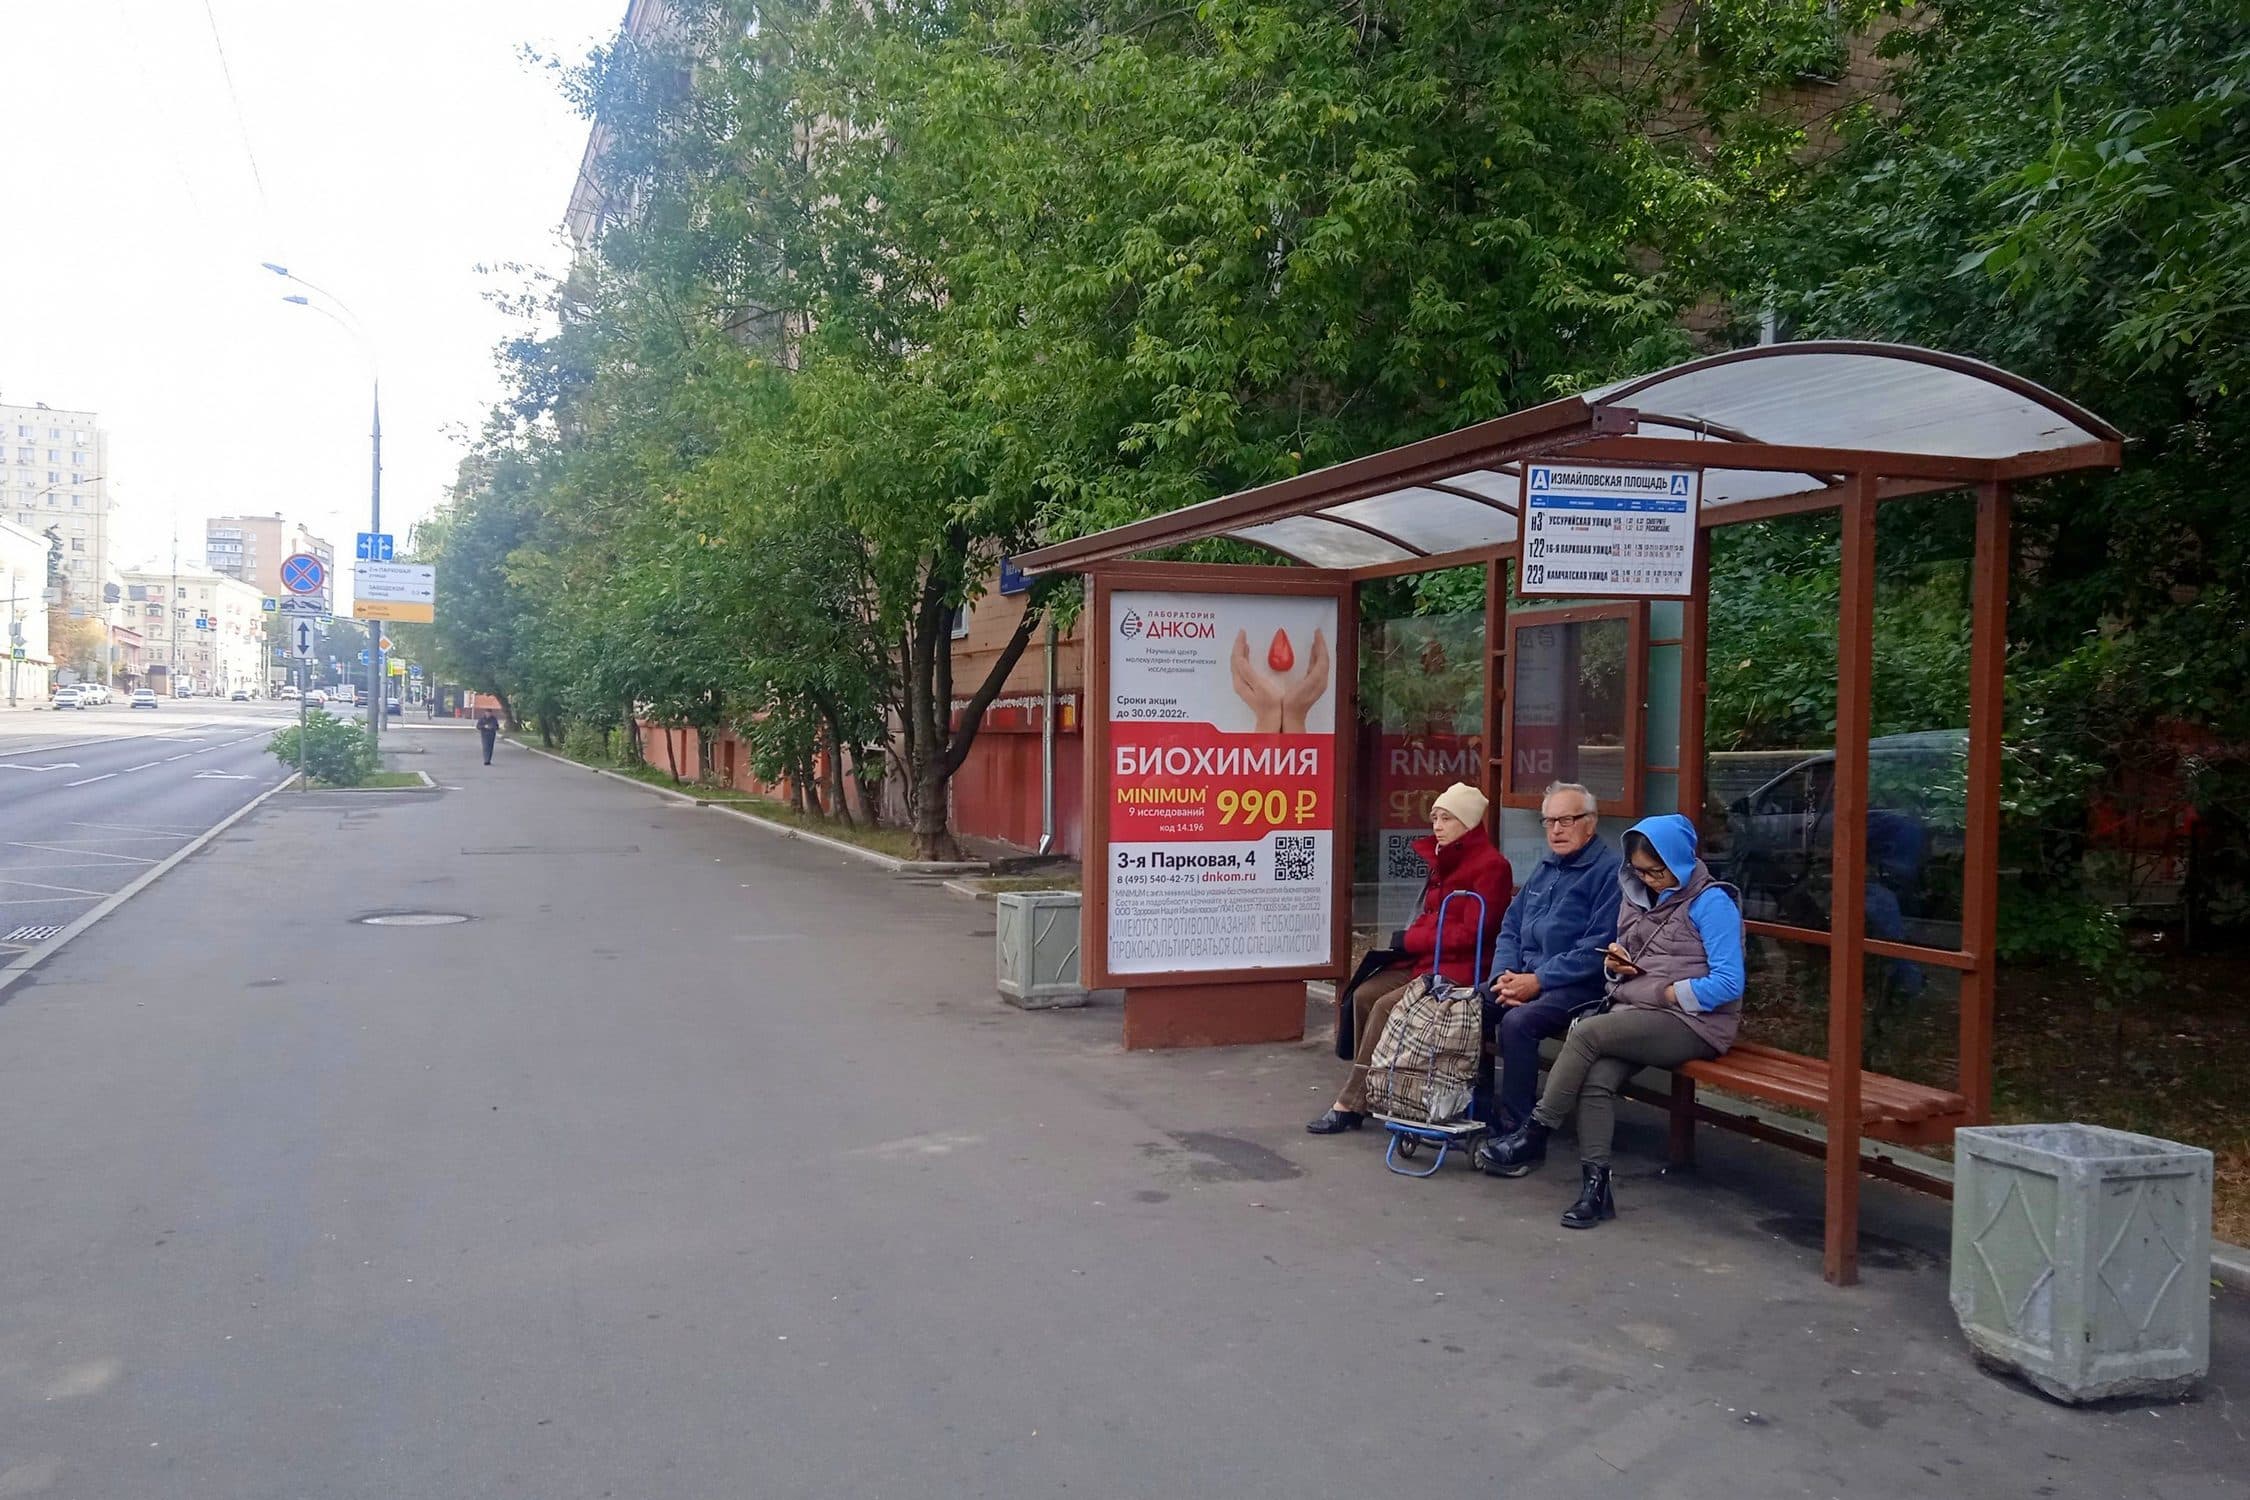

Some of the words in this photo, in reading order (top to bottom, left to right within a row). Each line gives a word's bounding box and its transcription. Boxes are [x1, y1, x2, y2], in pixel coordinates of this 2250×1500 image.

[1551, 471, 1622, 487] ИЗМАЙЛОВСКАЯ
[1624, 475, 1668, 490] ПЛОЩАДЬ
[1549, 515, 1591, 527] УССУРИЙСКАЯ
[1592, 517, 1612, 528] УЛИЦА
[1560, 544, 1592, 555] ПАРКОВАЯ
[1593, 546, 1612, 556] УЛИЦА
[1527, 564, 1544, 585] 223
[1547, 570, 1588, 580] КАМЧАТСКАЯ
[1589, 571, 1608, 582] УЛИЦА
[1148, 611, 1215, 619] ЛАБОРАТОРИЯ
[1146, 621, 1215, 639] ДНКОМ
[1117, 696, 1147, 705] Сроки
[1149, 697, 1177, 706] акции
[1116, 710, 1130, 719] до
[1131, 708, 1190, 719] 30.09.2022г.
[1116, 746, 1319, 776] БИОХИМИЯ
[1128, 807, 1136, 817] 9
[1137, 806, 1205, 819] исследований
[1159, 823, 1176, 833] код
[1177, 822, 1204, 832] 14.196
[1118, 852, 1147, 869] 3-я
[1151, 851, 1242, 871] Парковая,
[1244, 850, 1256, 867] 4
[1117, 874, 1123, 885] 8
[1125, 874, 1148, 885] (495)
[1149, 873, 1196, 885] 540-42-75
[1201, 871, 1257, 883] dnkom.ru
[1114, 907, 1131, 916] ООО
[1112, 918, 1159, 937] ИМЕЮТСЯ
[1261, 912, 1320, 933] НЕОБХОДИМО
[1112, 937, 1230, 959] ПРОКОНСУЛЬТИРОВАТЬСЯ
[1232, 936, 1245, 955] СО
[1247, 934, 1320, 956] СПЕЦИАЛИСТОМ
